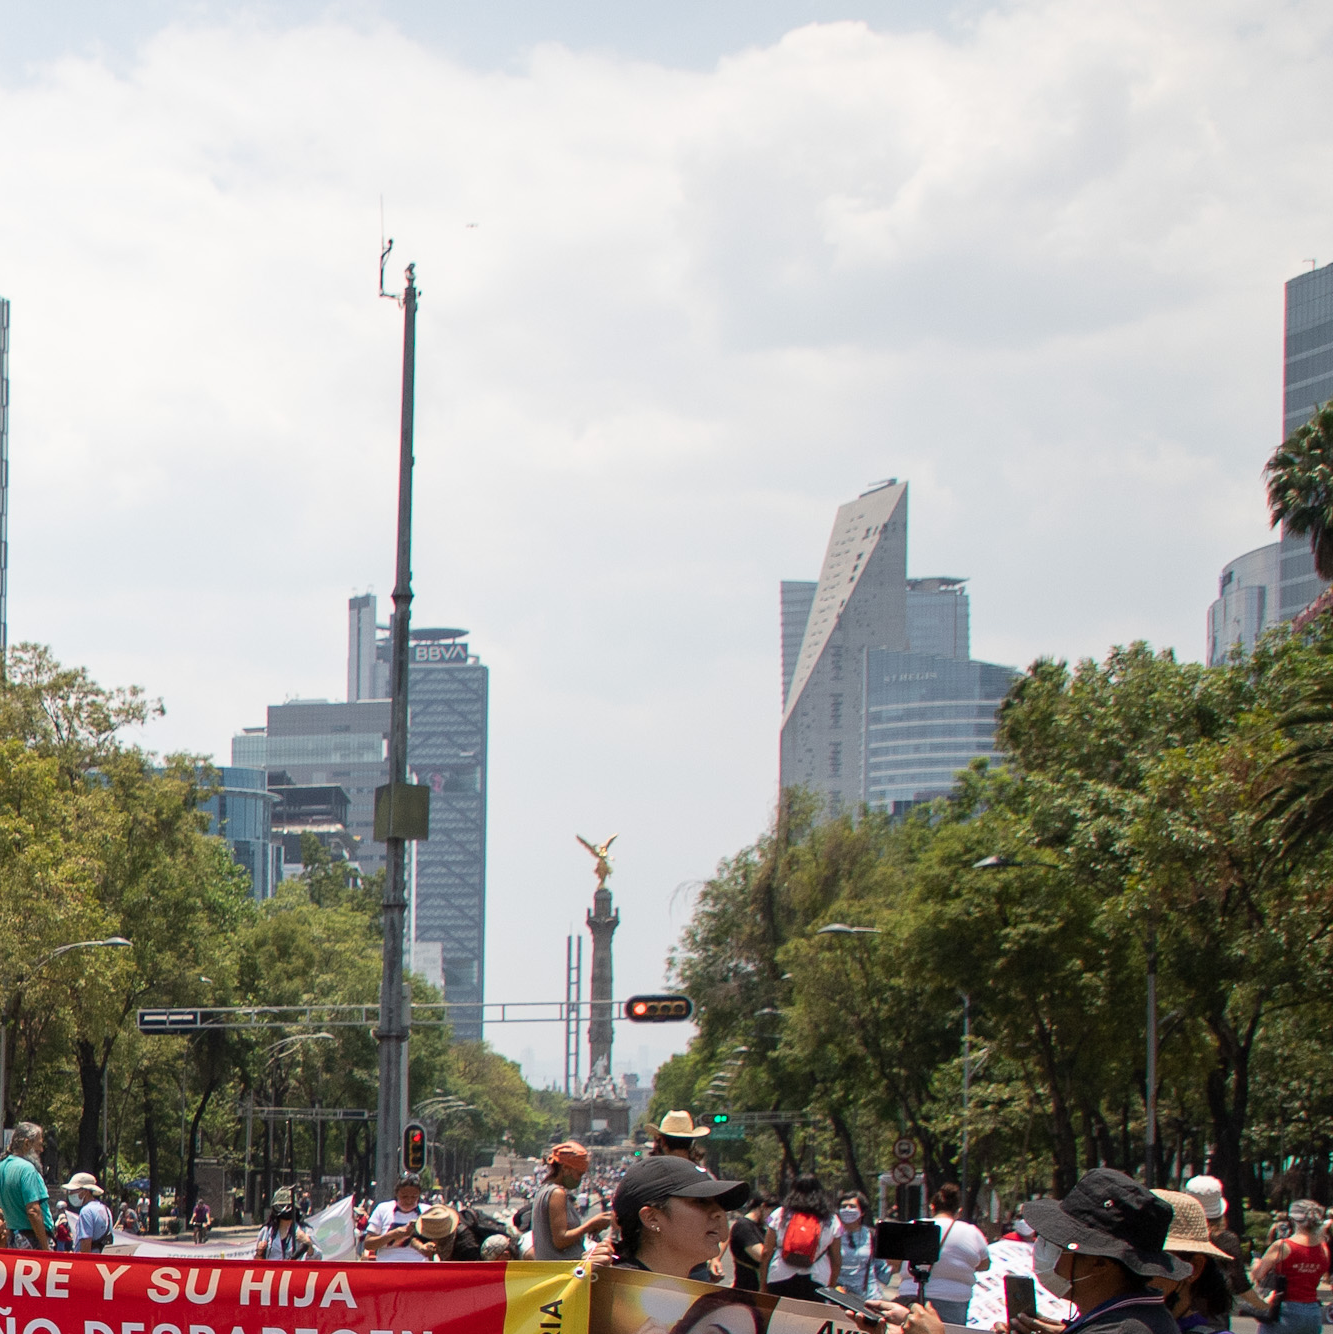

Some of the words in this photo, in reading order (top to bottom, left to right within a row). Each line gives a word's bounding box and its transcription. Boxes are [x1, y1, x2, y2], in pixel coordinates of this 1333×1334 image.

[416, 645, 466, 661] BBVA
[95, 1264, 131, 1301] Y
[146, 1267, 222, 1304] SU
[239, 1269, 358, 1309] HIJA
